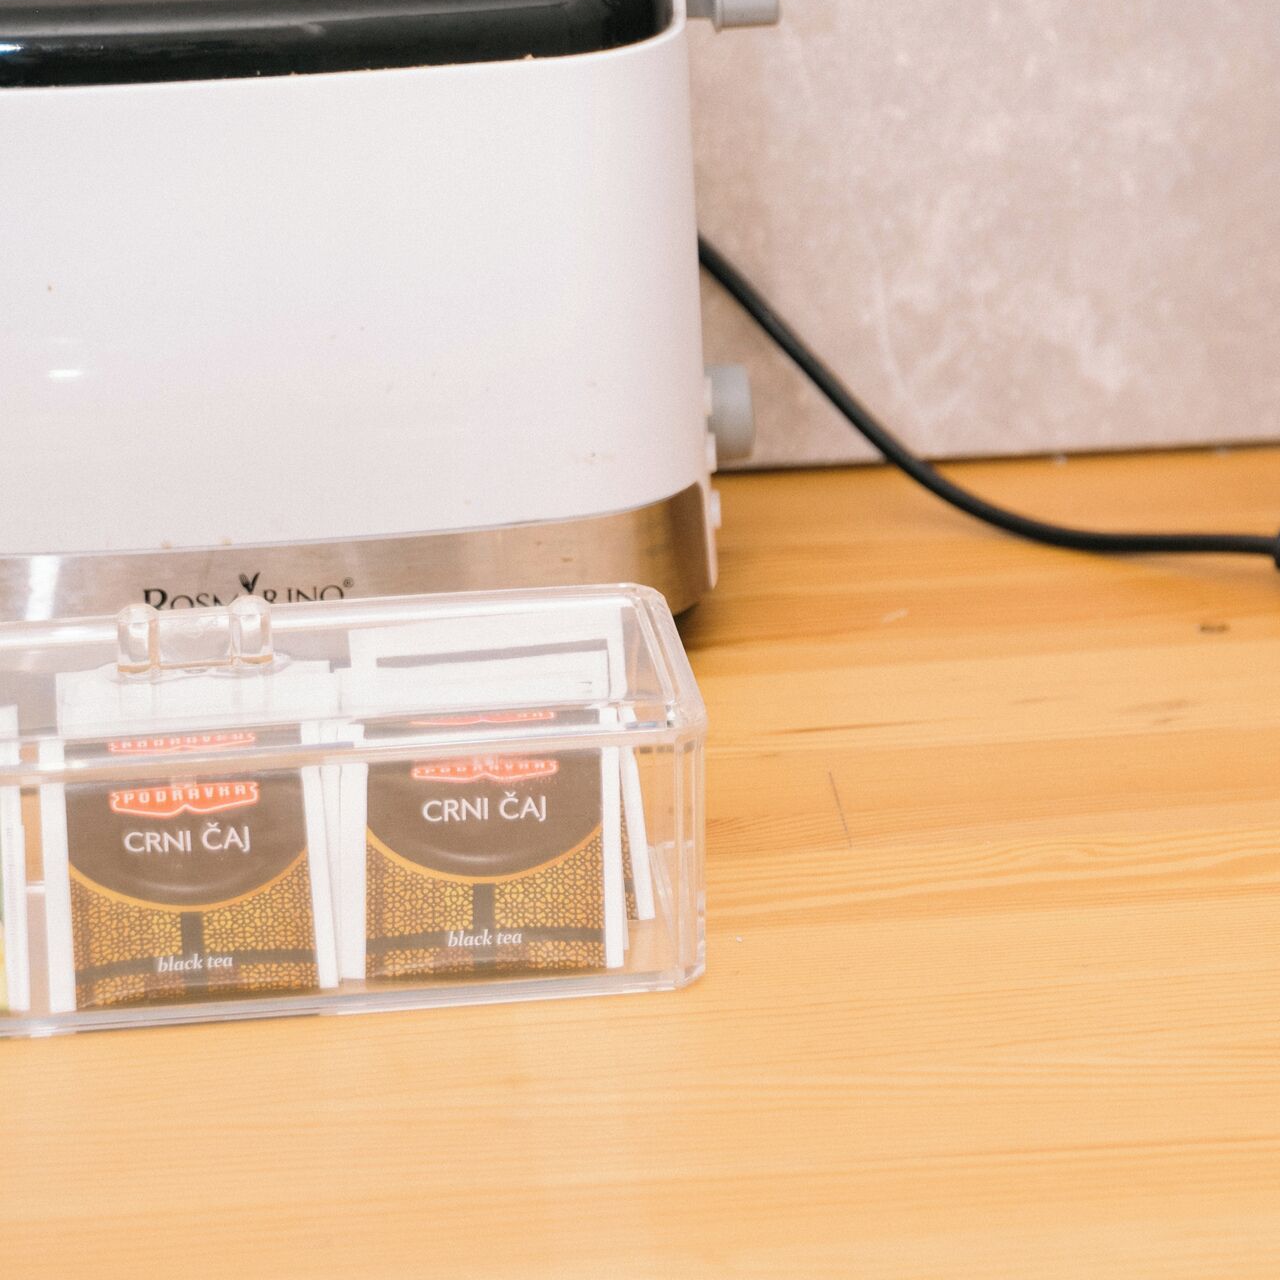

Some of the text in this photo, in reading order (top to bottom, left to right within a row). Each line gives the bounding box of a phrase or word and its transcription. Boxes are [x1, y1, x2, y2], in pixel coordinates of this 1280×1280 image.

[124, 784, 246, 805] PODRAVKA
[422, 791, 547, 822] CRNI ČAJ
[123, 821, 250, 853] CRNI ČAJ
[448, 928, 522, 947] black tea
[158, 953, 233, 972] black tea
